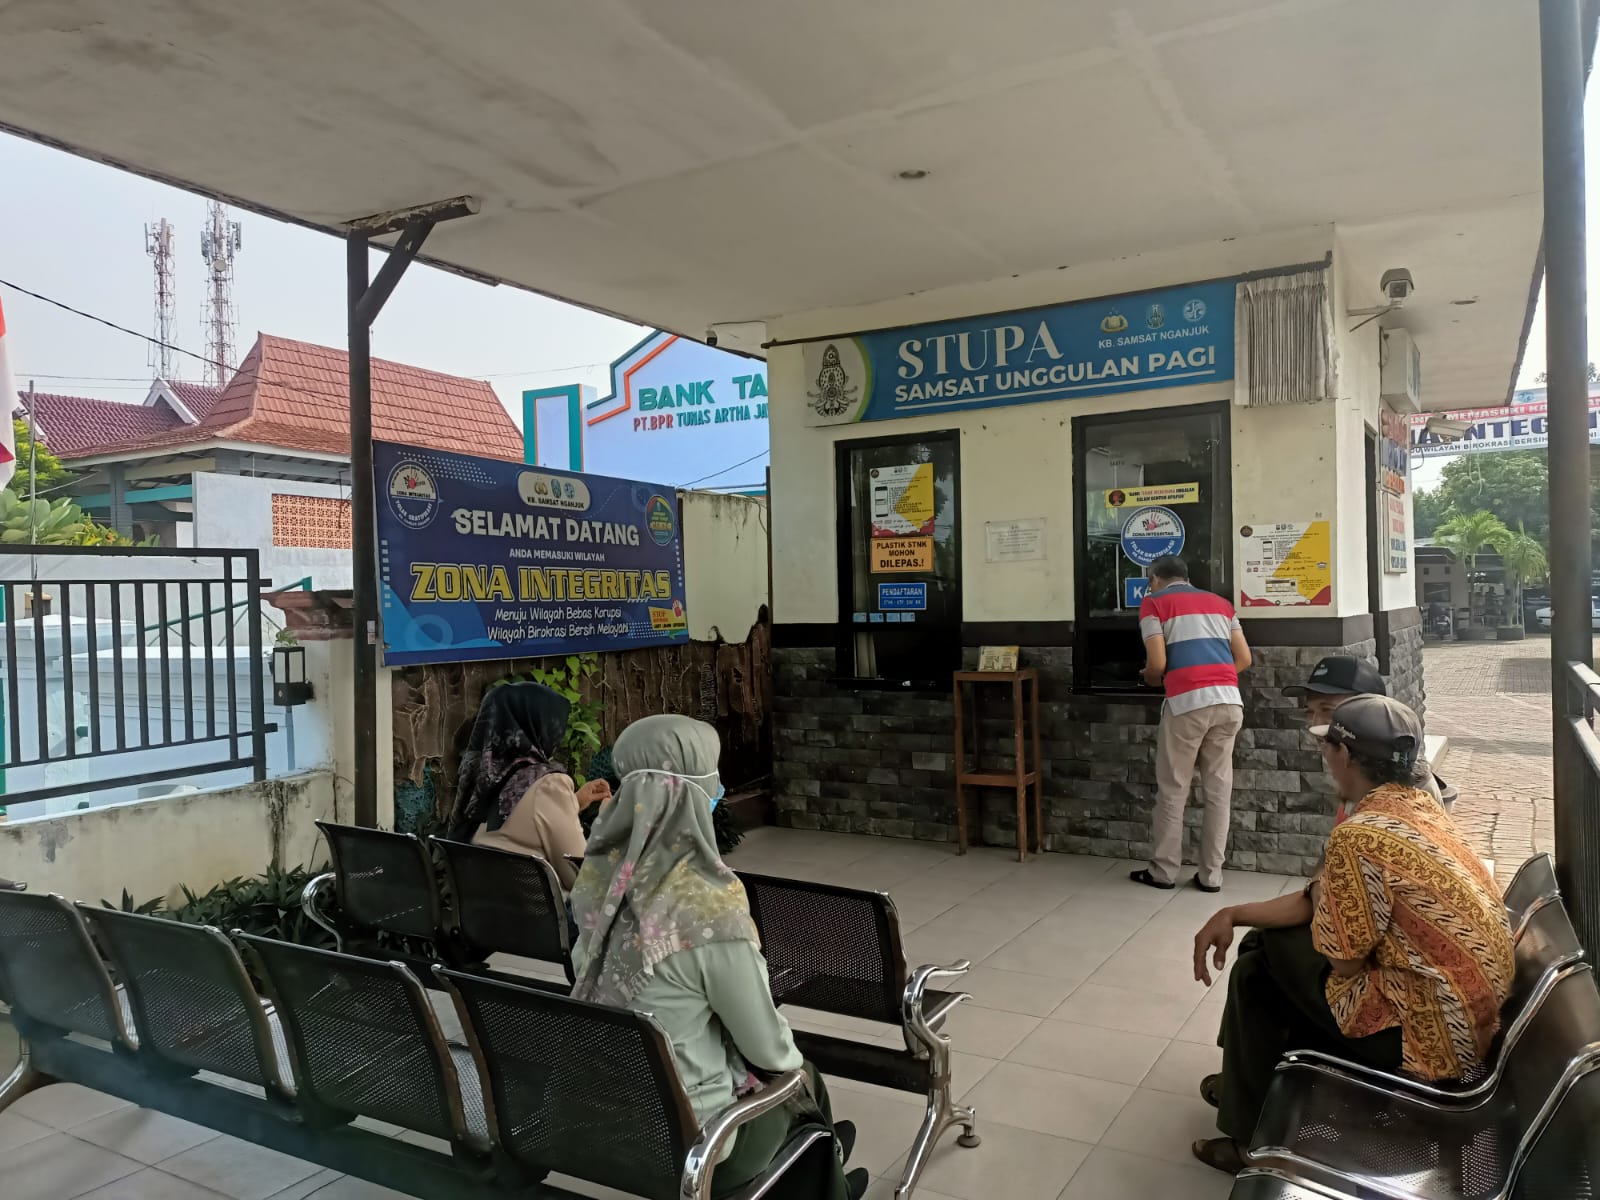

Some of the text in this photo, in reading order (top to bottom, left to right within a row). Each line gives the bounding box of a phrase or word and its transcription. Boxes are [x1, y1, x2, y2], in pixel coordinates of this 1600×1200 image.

[1098, 325, 1209, 349] KB. SAMSAT NGANJUK
[897, 320, 1064, 379] STUPA
[895, 345, 1216, 403] SAMSAT UNGGULAN PAGI
[638, 373, 769, 411] BANK TA
[633, 403, 769, 432] PT.BPR TUNAS ARTHA JA
[1446, 407, 1525, 420] MEMASUKI
[1530, 404, 1548, 413] KA
[1464, 417, 1548, 441] NTEG
[1422, 444, 1460, 453] WILAYAH
[1463, 439, 1512, 450] BIROKRASI
[452, 508, 561, 540] SELAMAT
[566, 519, 640, 546] DATANG
[509, 548, 605, 562] ANDA MEMASUKI WILAYAH
[876, 541, 927, 550] PLASTIK STNK
[889, 549, 915, 557] MOHON
[410, 563, 673, 602] ZONA INTEGRITAS
[1133, 586, 1152, 599] KA
[495, 606, 622, 622] Menuju Wilayah Bebas Korupsi
[487, 623, 629, 643] Wilayah Birokrasi Bersih Melayani
